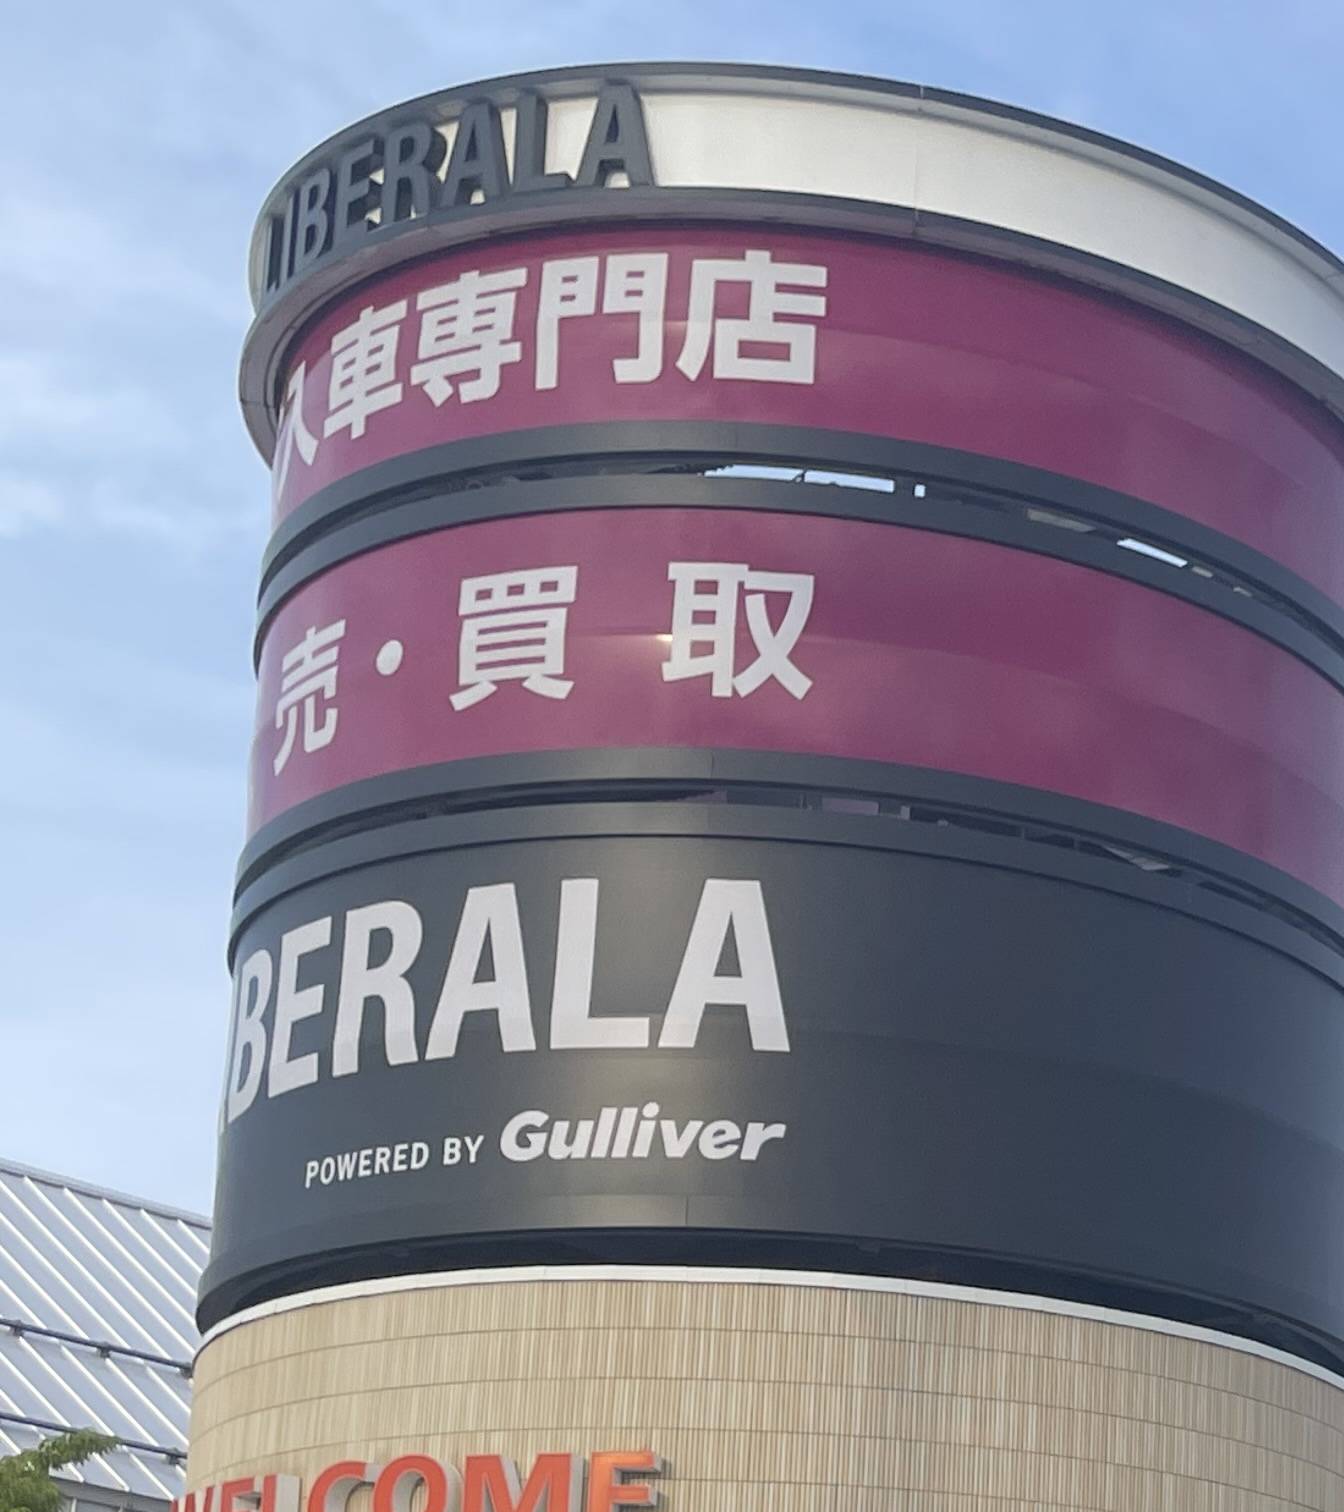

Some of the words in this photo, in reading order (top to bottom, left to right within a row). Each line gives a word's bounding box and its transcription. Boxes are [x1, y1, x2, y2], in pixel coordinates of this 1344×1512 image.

[264, 81, 656, 296] LIBERALA
[305, 1143, 429, 1188] POWERED
[443, 1135, 484, 1166] BY
[499, 1102, 787, 1162] Gulliver
